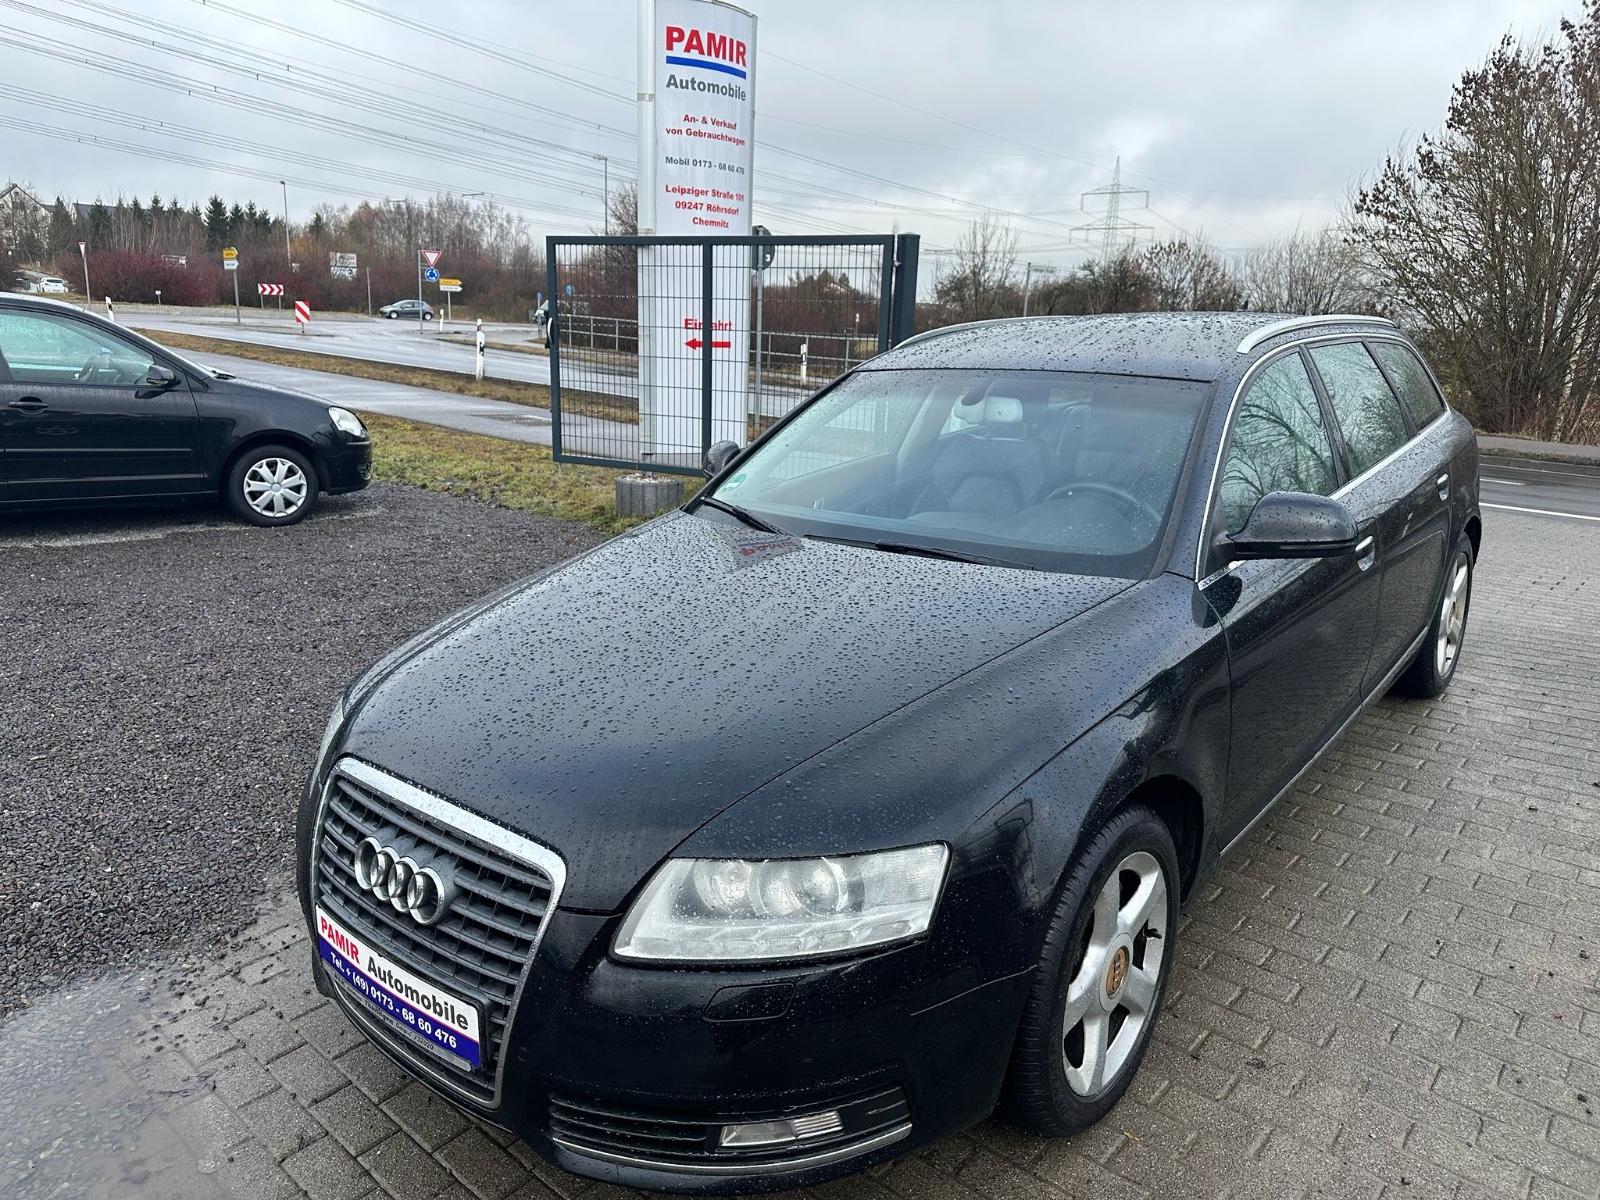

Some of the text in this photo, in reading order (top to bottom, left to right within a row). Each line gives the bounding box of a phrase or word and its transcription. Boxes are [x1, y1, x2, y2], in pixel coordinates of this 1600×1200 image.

[665, 25, 747, 67] PAMIR
[665, 74, 746, 101] Automobile
[683, 114, 737, 130] An- & Verkauf
[665, 127, 745, 146] von Gebrauchtwagen
[665, 156, 690, 166] Mobil
[692, 158, 712, 169] 0173
[718, 162, 726, 171] 68
[728, 164, 735, 173] 60
[665, 185, 709, 198] Leipziger
[711, 189, 734, 200] Straße
[675, 201, 739, 215] 09247 Röhrsdorf
[692, 217, 730, 229] Chemnitz
[320, 915, 361, 964] PAMIR
[367, 955, 469, 1031] Automobile
[352, 971, 369, 995] (49)
[370, 985, 394, 1010] 0173
[402, 1007, 415, 1025] 68
[418, 1017, 432, 1035] 60
[434, 1028, 457, 1049] 476
